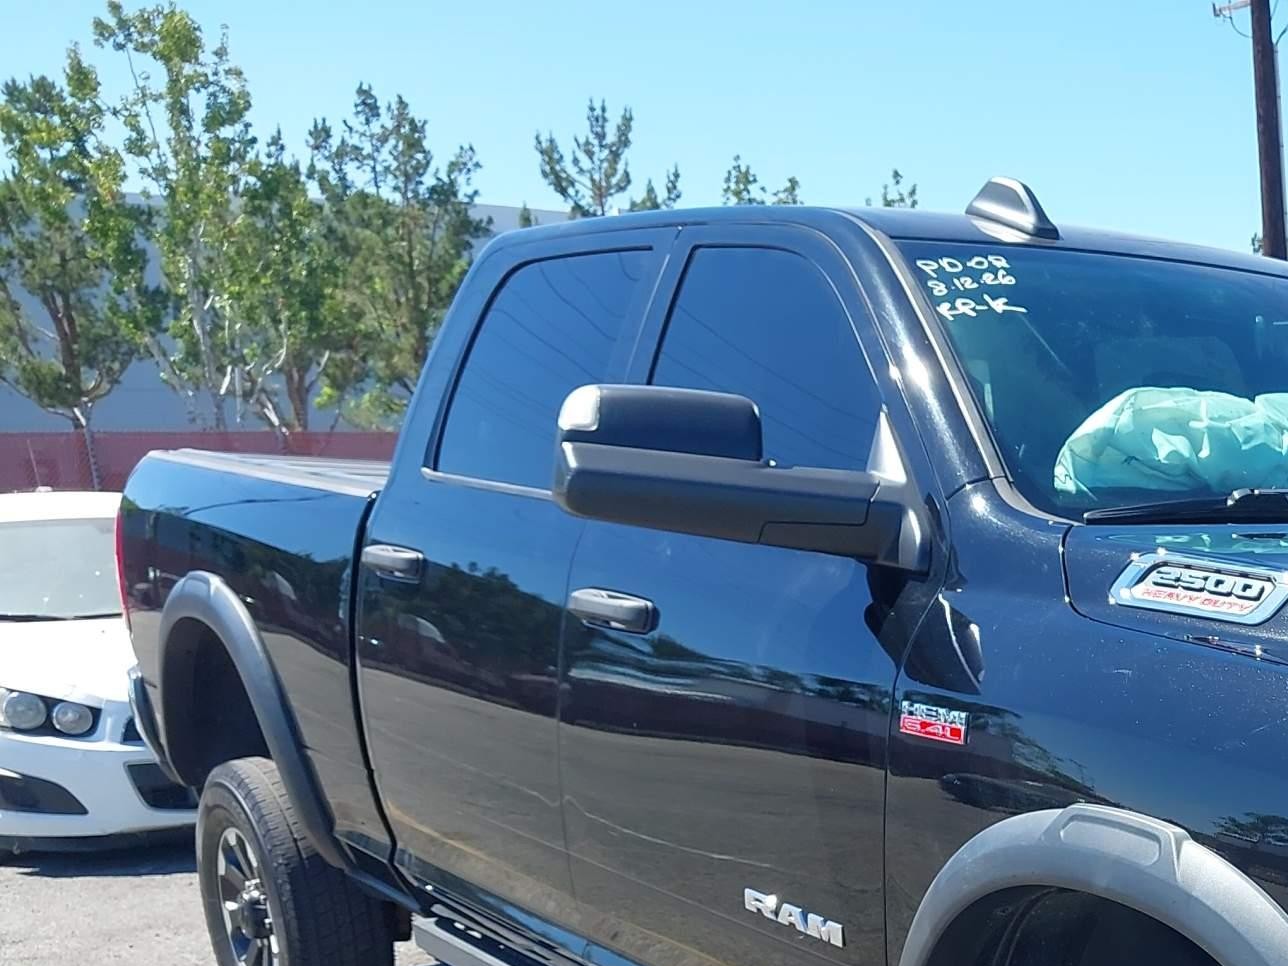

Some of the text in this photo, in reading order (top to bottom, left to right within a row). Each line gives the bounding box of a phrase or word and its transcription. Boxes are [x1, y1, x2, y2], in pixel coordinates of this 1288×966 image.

[1140, 586, 1255, 612] HEAVY DUTY
[1151, 568, 1266, 602] 2500
[744, 887, 846, 949] RAM
